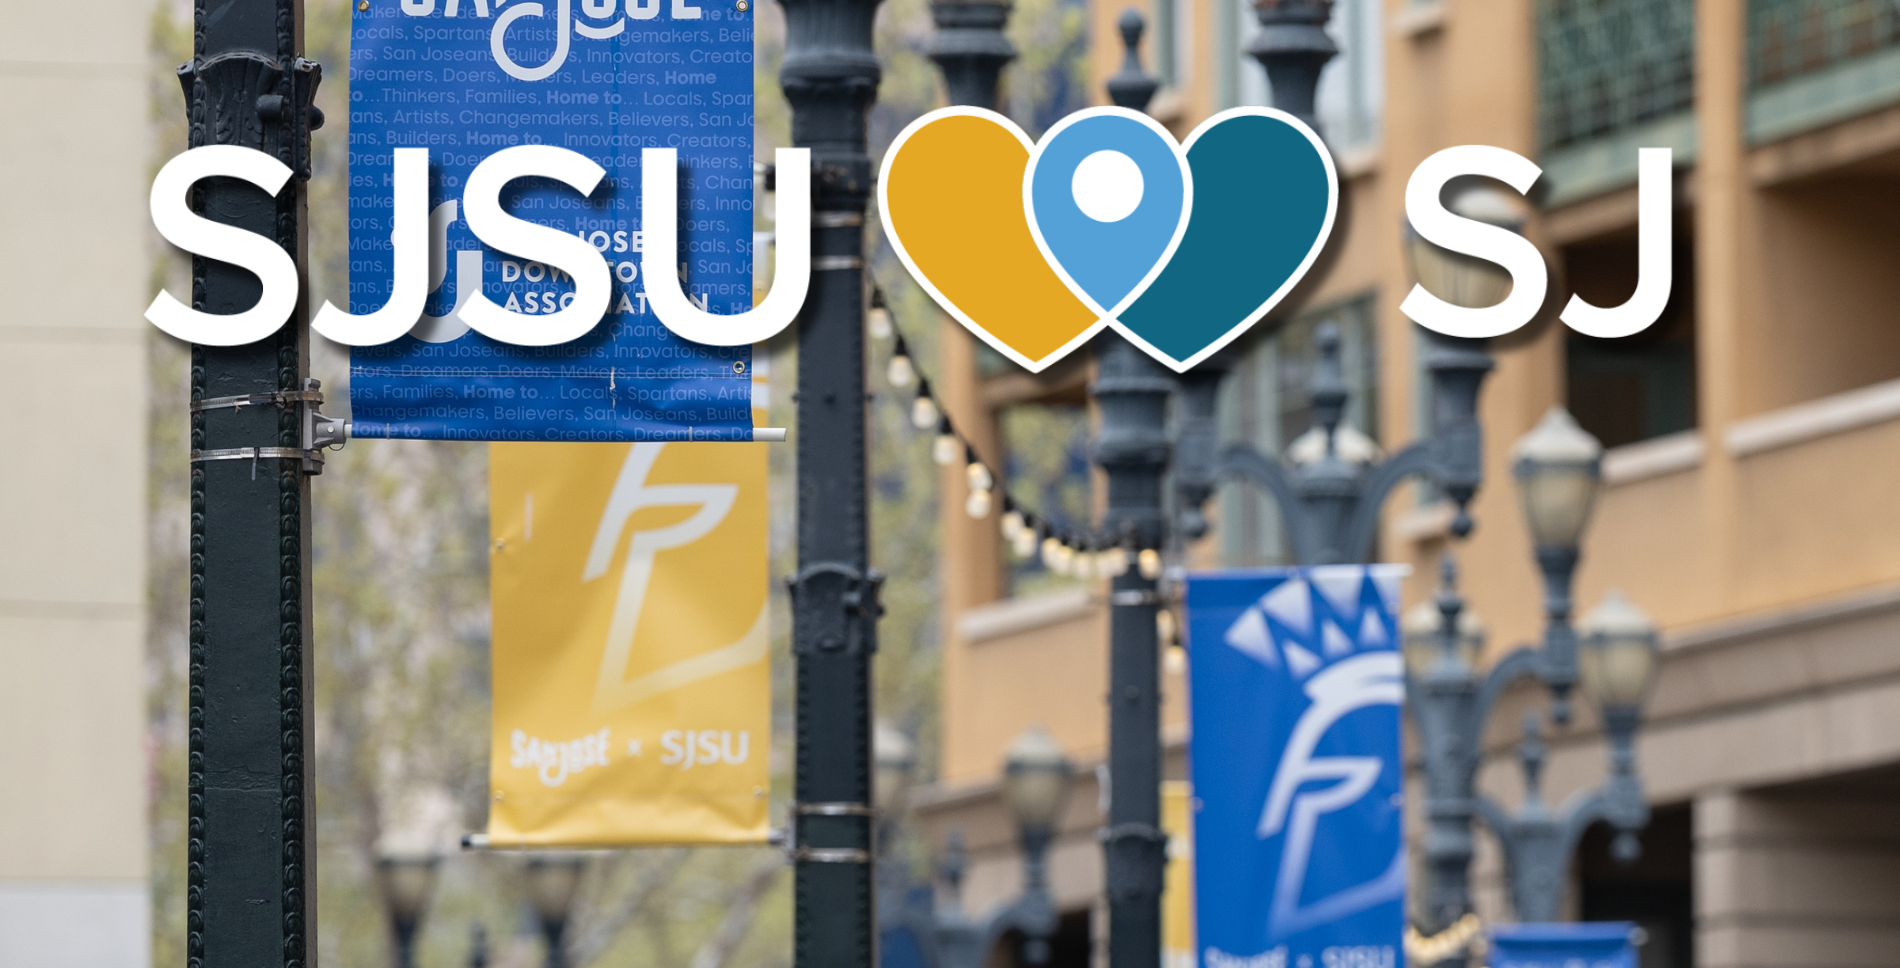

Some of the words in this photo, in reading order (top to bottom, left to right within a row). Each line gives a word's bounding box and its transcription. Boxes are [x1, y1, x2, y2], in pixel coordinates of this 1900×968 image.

[383, 46, 416, 60] San
[587, 49, 685, 65] Innovators,
[443, 68, 501, 84] Doers,
[582, 69, 660, 86] Leaders,
[664, 71, 717, 84] Home
[382, 88, 460, 104] Thinkers,
[465, 89, 542, 105] Families,
[546, 90, 599, 105] Home
[644, 92, 707, 107] Locals,
[393, 110, 454, 126] Artists,
[459, 110, 603, 128] Changemakers,
[608, 111, 694, 128] Believers,
[699, 112, 732, 127] San
[386, 130, 461, 146] Builders,
[466, 131, 519, 145] Home
[564, 132, 661, 149] Innovators,
[667, 133, 751, 149] Creators,
[511, 195, 544, 209] San
[549, 195, 630, 211] Joseans,
[575, 216, 628, 230] Home
[698, 259, 731, 274] San
[411, 343, 444, 357] San
[449, 343, 530, 359] Joseans,
[614, 344, 713, 360] Innovators,
[401, 364, 493, 380] Dreamers,
[498, 364, 555, 380] Doers,
[635, 365, 714, 381] Leaders,
[383, 385, 459, 401] Families,
[463, 385, 516, 399] Home
[560, 385, 622, 402] Locals,
[627, 387, 711, 403] Spartans,
[494, 405, 579, 422] Believers,
[584, 406, 617, 420] San
[621, 407, 701, 422] Joseans,
[443, 425, 541, 441] Innovators,
[545, 427, 628, 442] Creators,
[634, 427, 725, 442] Dreamers,
[660, 728, 750, 771] SJSU
